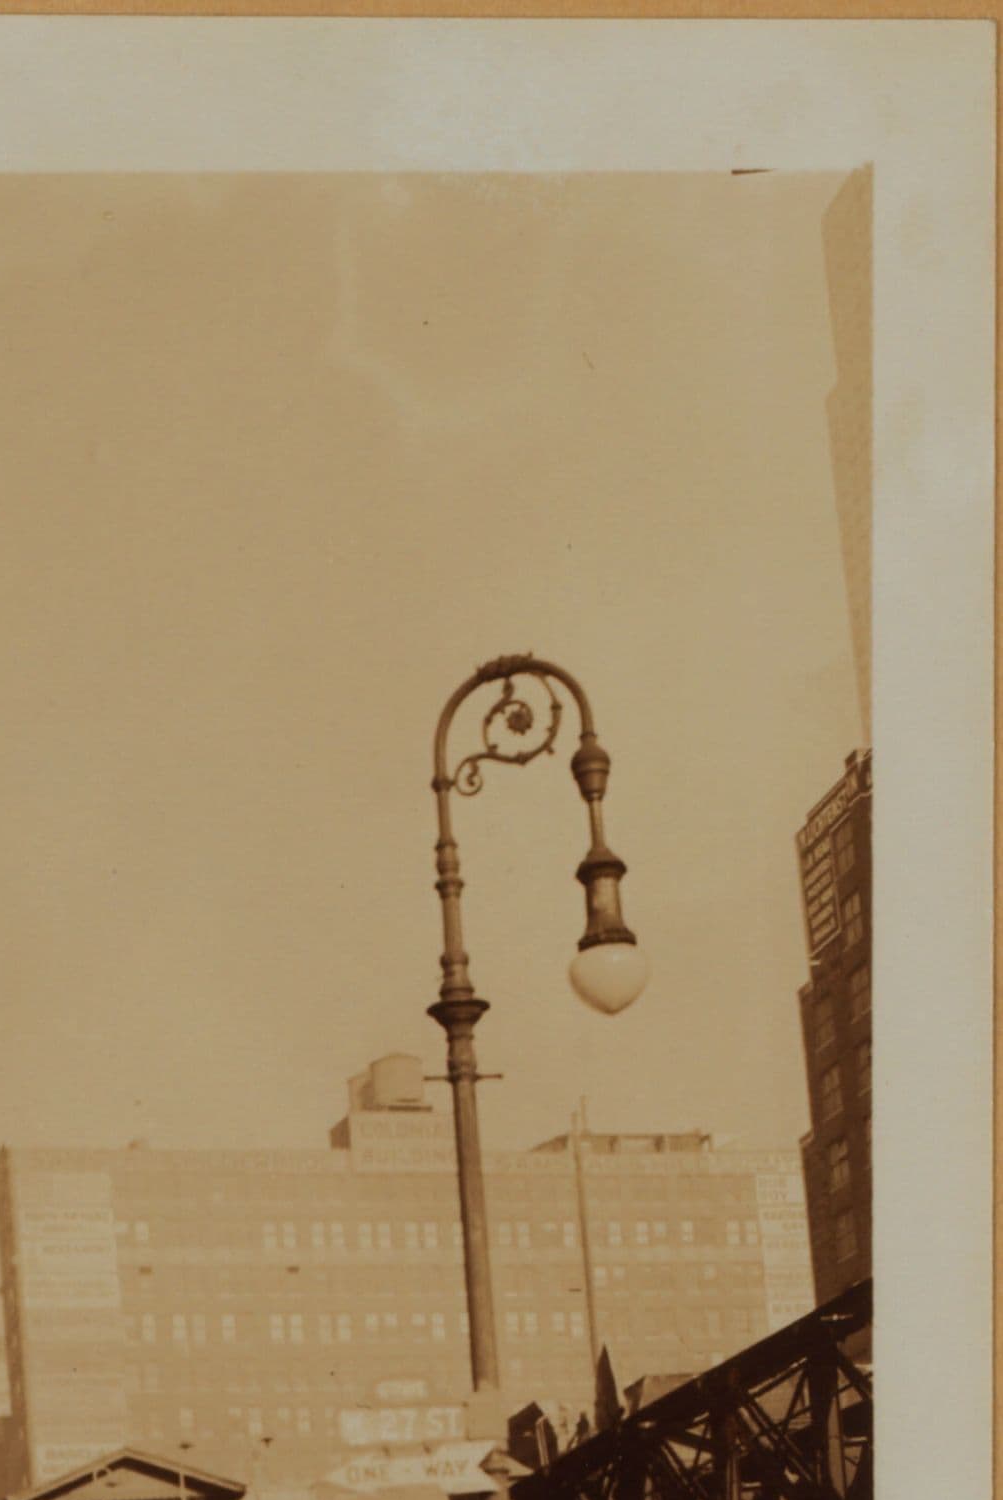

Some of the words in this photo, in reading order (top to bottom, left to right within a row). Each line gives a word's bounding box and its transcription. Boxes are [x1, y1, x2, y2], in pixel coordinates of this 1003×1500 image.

[379, 1410, 417, 1441] 27
[427, 1407, 462, 1437] ST
[347, 1464, 390, 1483] ONE
[425, 1459, 468, 1477] WAY
